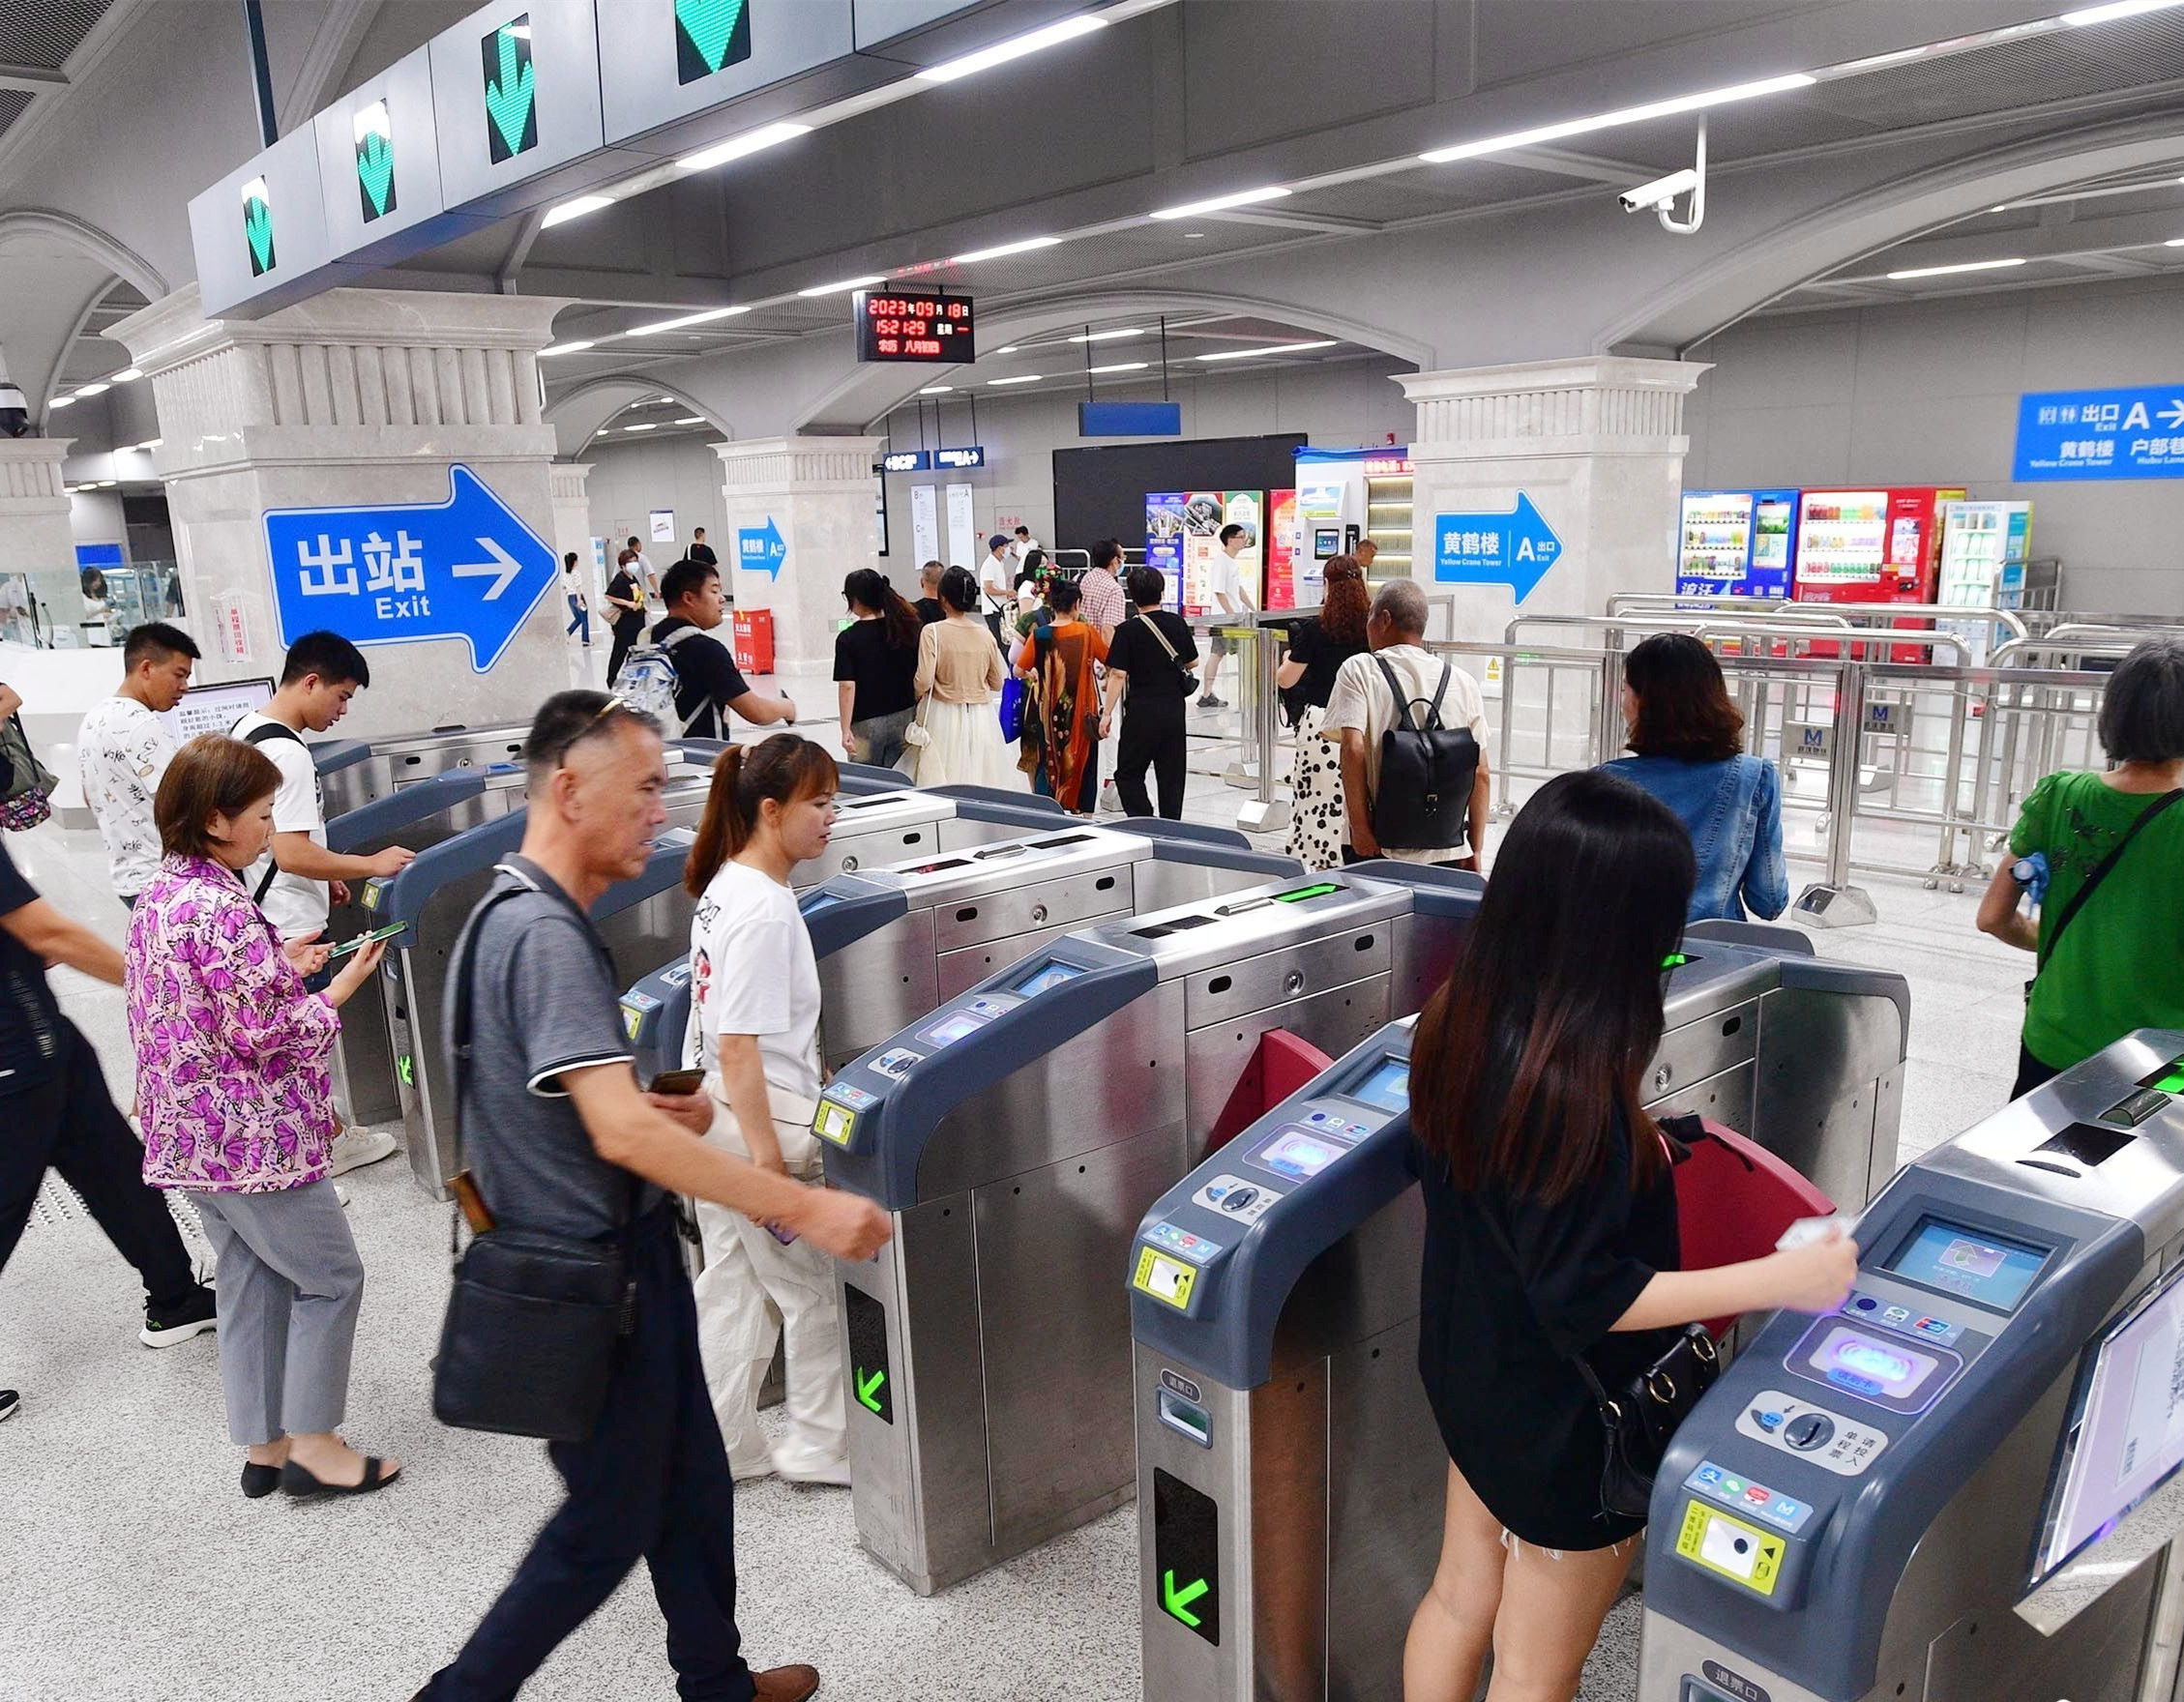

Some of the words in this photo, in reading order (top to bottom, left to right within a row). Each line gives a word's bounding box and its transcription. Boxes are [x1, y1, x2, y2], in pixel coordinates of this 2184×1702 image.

[2081, 403, 2121, 423] 出口
[2121, 401, 2150, 430] A
[2094, 422, 2116, 432] Exit
[2059, 439, 2115, 458] 黄鹤楼
[770, 542, 778, 556] A
[1443, 531, 1499, 555] 黄鹤楼
[1516, 537, 1536, 561] A
[1537, 541, 1555, 552] 出口
[297, 530, 426, 596] 出站
[1461, 558, 1481, 567] Crane
[1482, 558, 1502, 567] Tower
[375, 595, 430, 619] Exit
[1829, 1430, 1858, 1460] 单程票
[1715, 1670, 1757, 1700] 退票口
